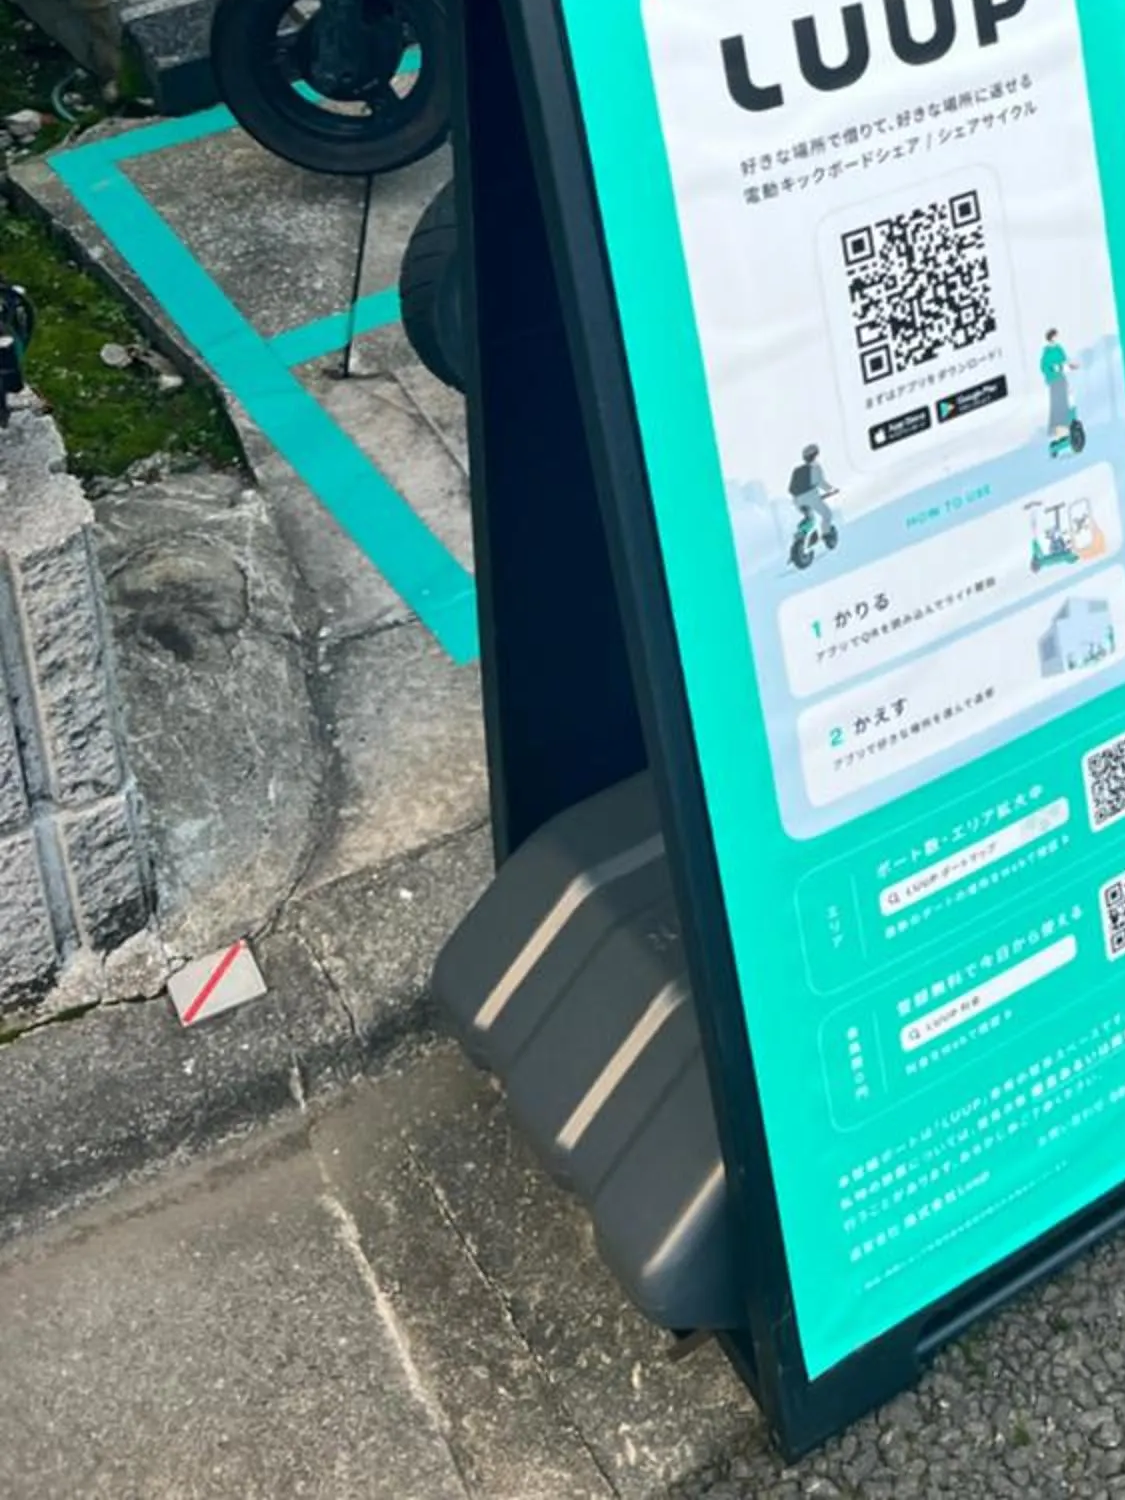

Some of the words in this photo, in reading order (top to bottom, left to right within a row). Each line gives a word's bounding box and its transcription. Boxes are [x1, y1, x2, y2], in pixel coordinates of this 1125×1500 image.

[738, 71, 1034, 177] 好きな場所で借りて、好きな場所に返せる
[741, 134, 921, 206] 電動キックボードシェア
[936, 98, 1039, 146] シェアサイクル
[943, 494, 963, 513] TO
[832, 590, 891, 630] かりる
[827, 723, 846, 749] 2
[852, 696, 908, 736] かえす
